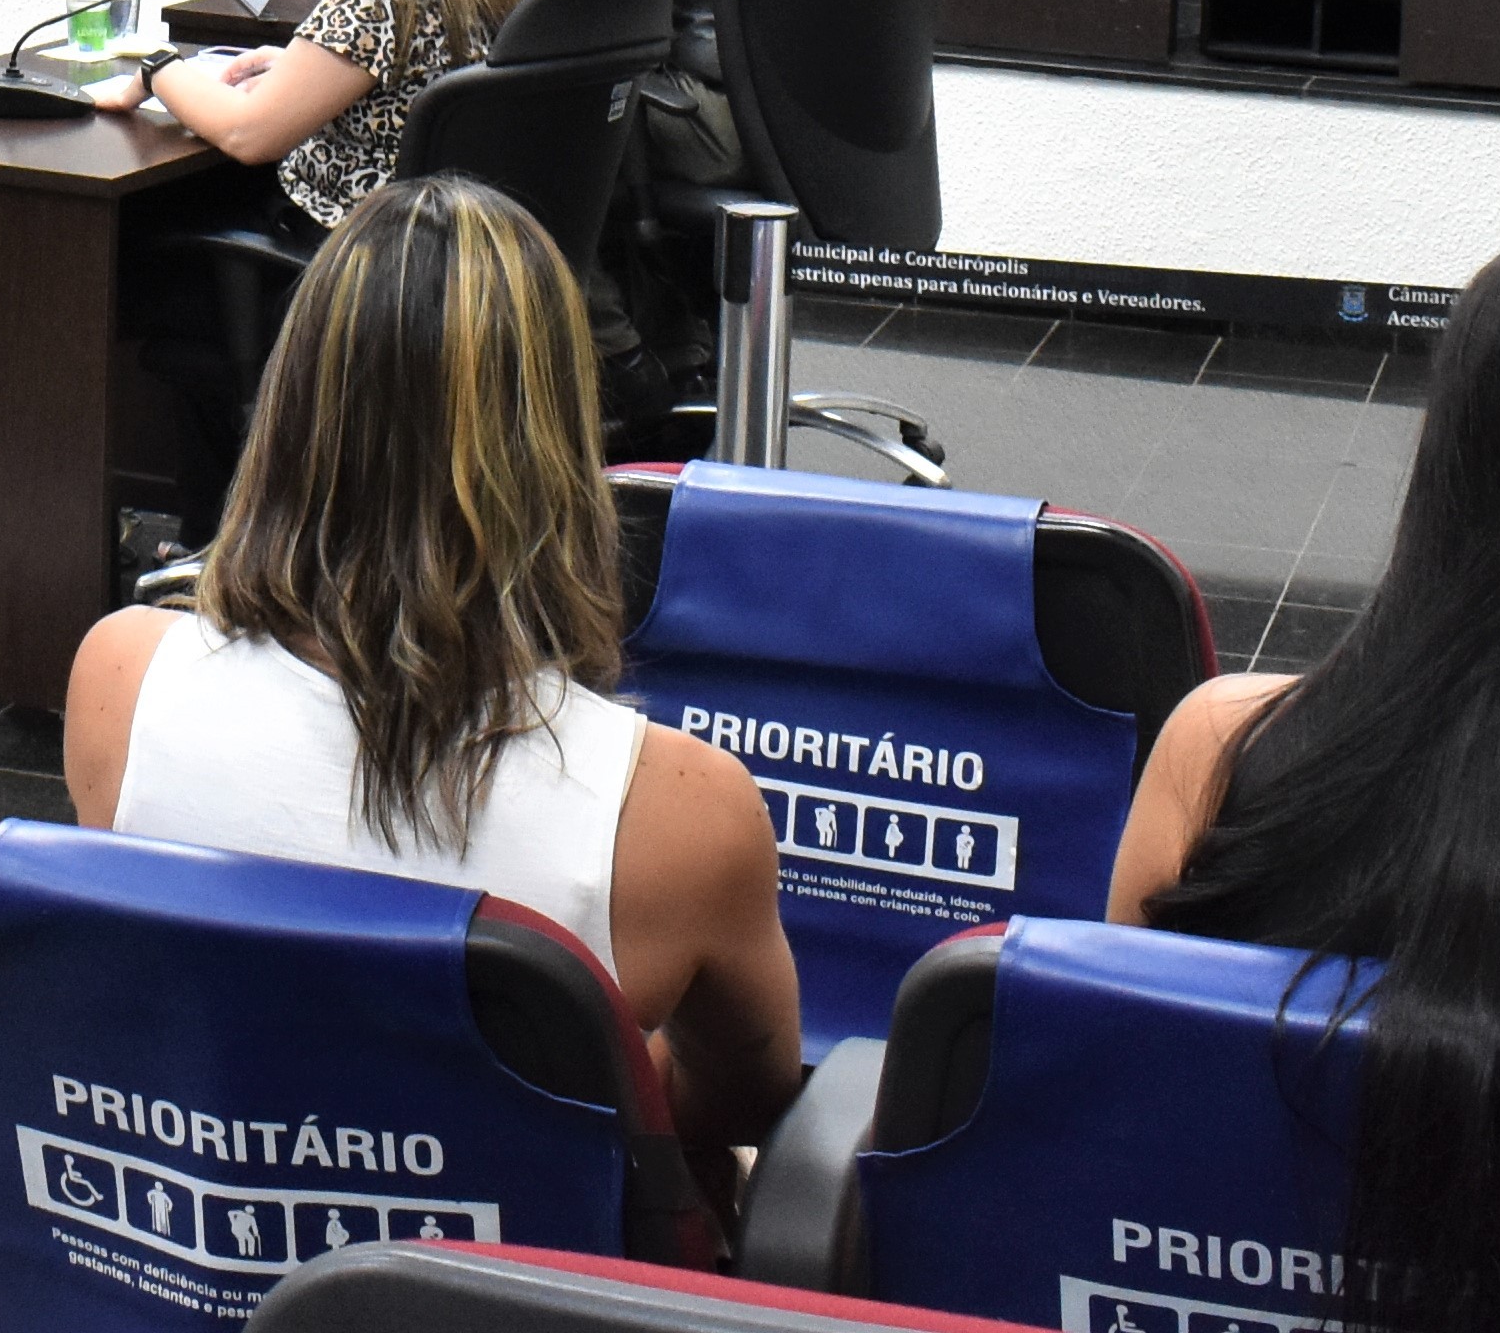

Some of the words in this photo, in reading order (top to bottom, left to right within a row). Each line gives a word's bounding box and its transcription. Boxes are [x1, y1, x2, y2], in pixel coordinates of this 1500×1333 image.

[878, 247, 901, 265] de
[905, 250, 1029, 276] Cordeirópolis
[849, 273, 913, 290] apenas
[917, 278, 959, 295] para
[962, 279, 1078, 303] funcionários
[1081, 291, 1093, 304] e
[1097, 287, 1207, 313] Vereadores.
[681, 706, 985, 792] PRIORITÁRIO
[787, 884, 795, 894] e
[797, 884, 848, 903] pessoas
[850, 893, 877, 908] com
[879, 896, 932, 916] crianças
[934, 904, 951, 920] de
[953, 908, 981, 924] colo
[802, 871, 818, 884] ou
[820, 873, 887, 896] mobilidade
[890, 885, 947, 907] reduzida,
[949, 894, 996, 914] idosos,
[52, 1074, 445, 1177] PRIORITÁRIO
[52, 1227, 108, 1260] Pessoas
[112, 1251, 141, 1270] com
[143, 1261, 217, 1299] deficiência
[222, 1288, 244, 1302] ou
[68, 1250, 136, 1288] gestantes,
[138, 1276, 200, 1311] lactantes
[204, 1302, 213, 1315] e
[217, 1304, 254, 1319] pess
